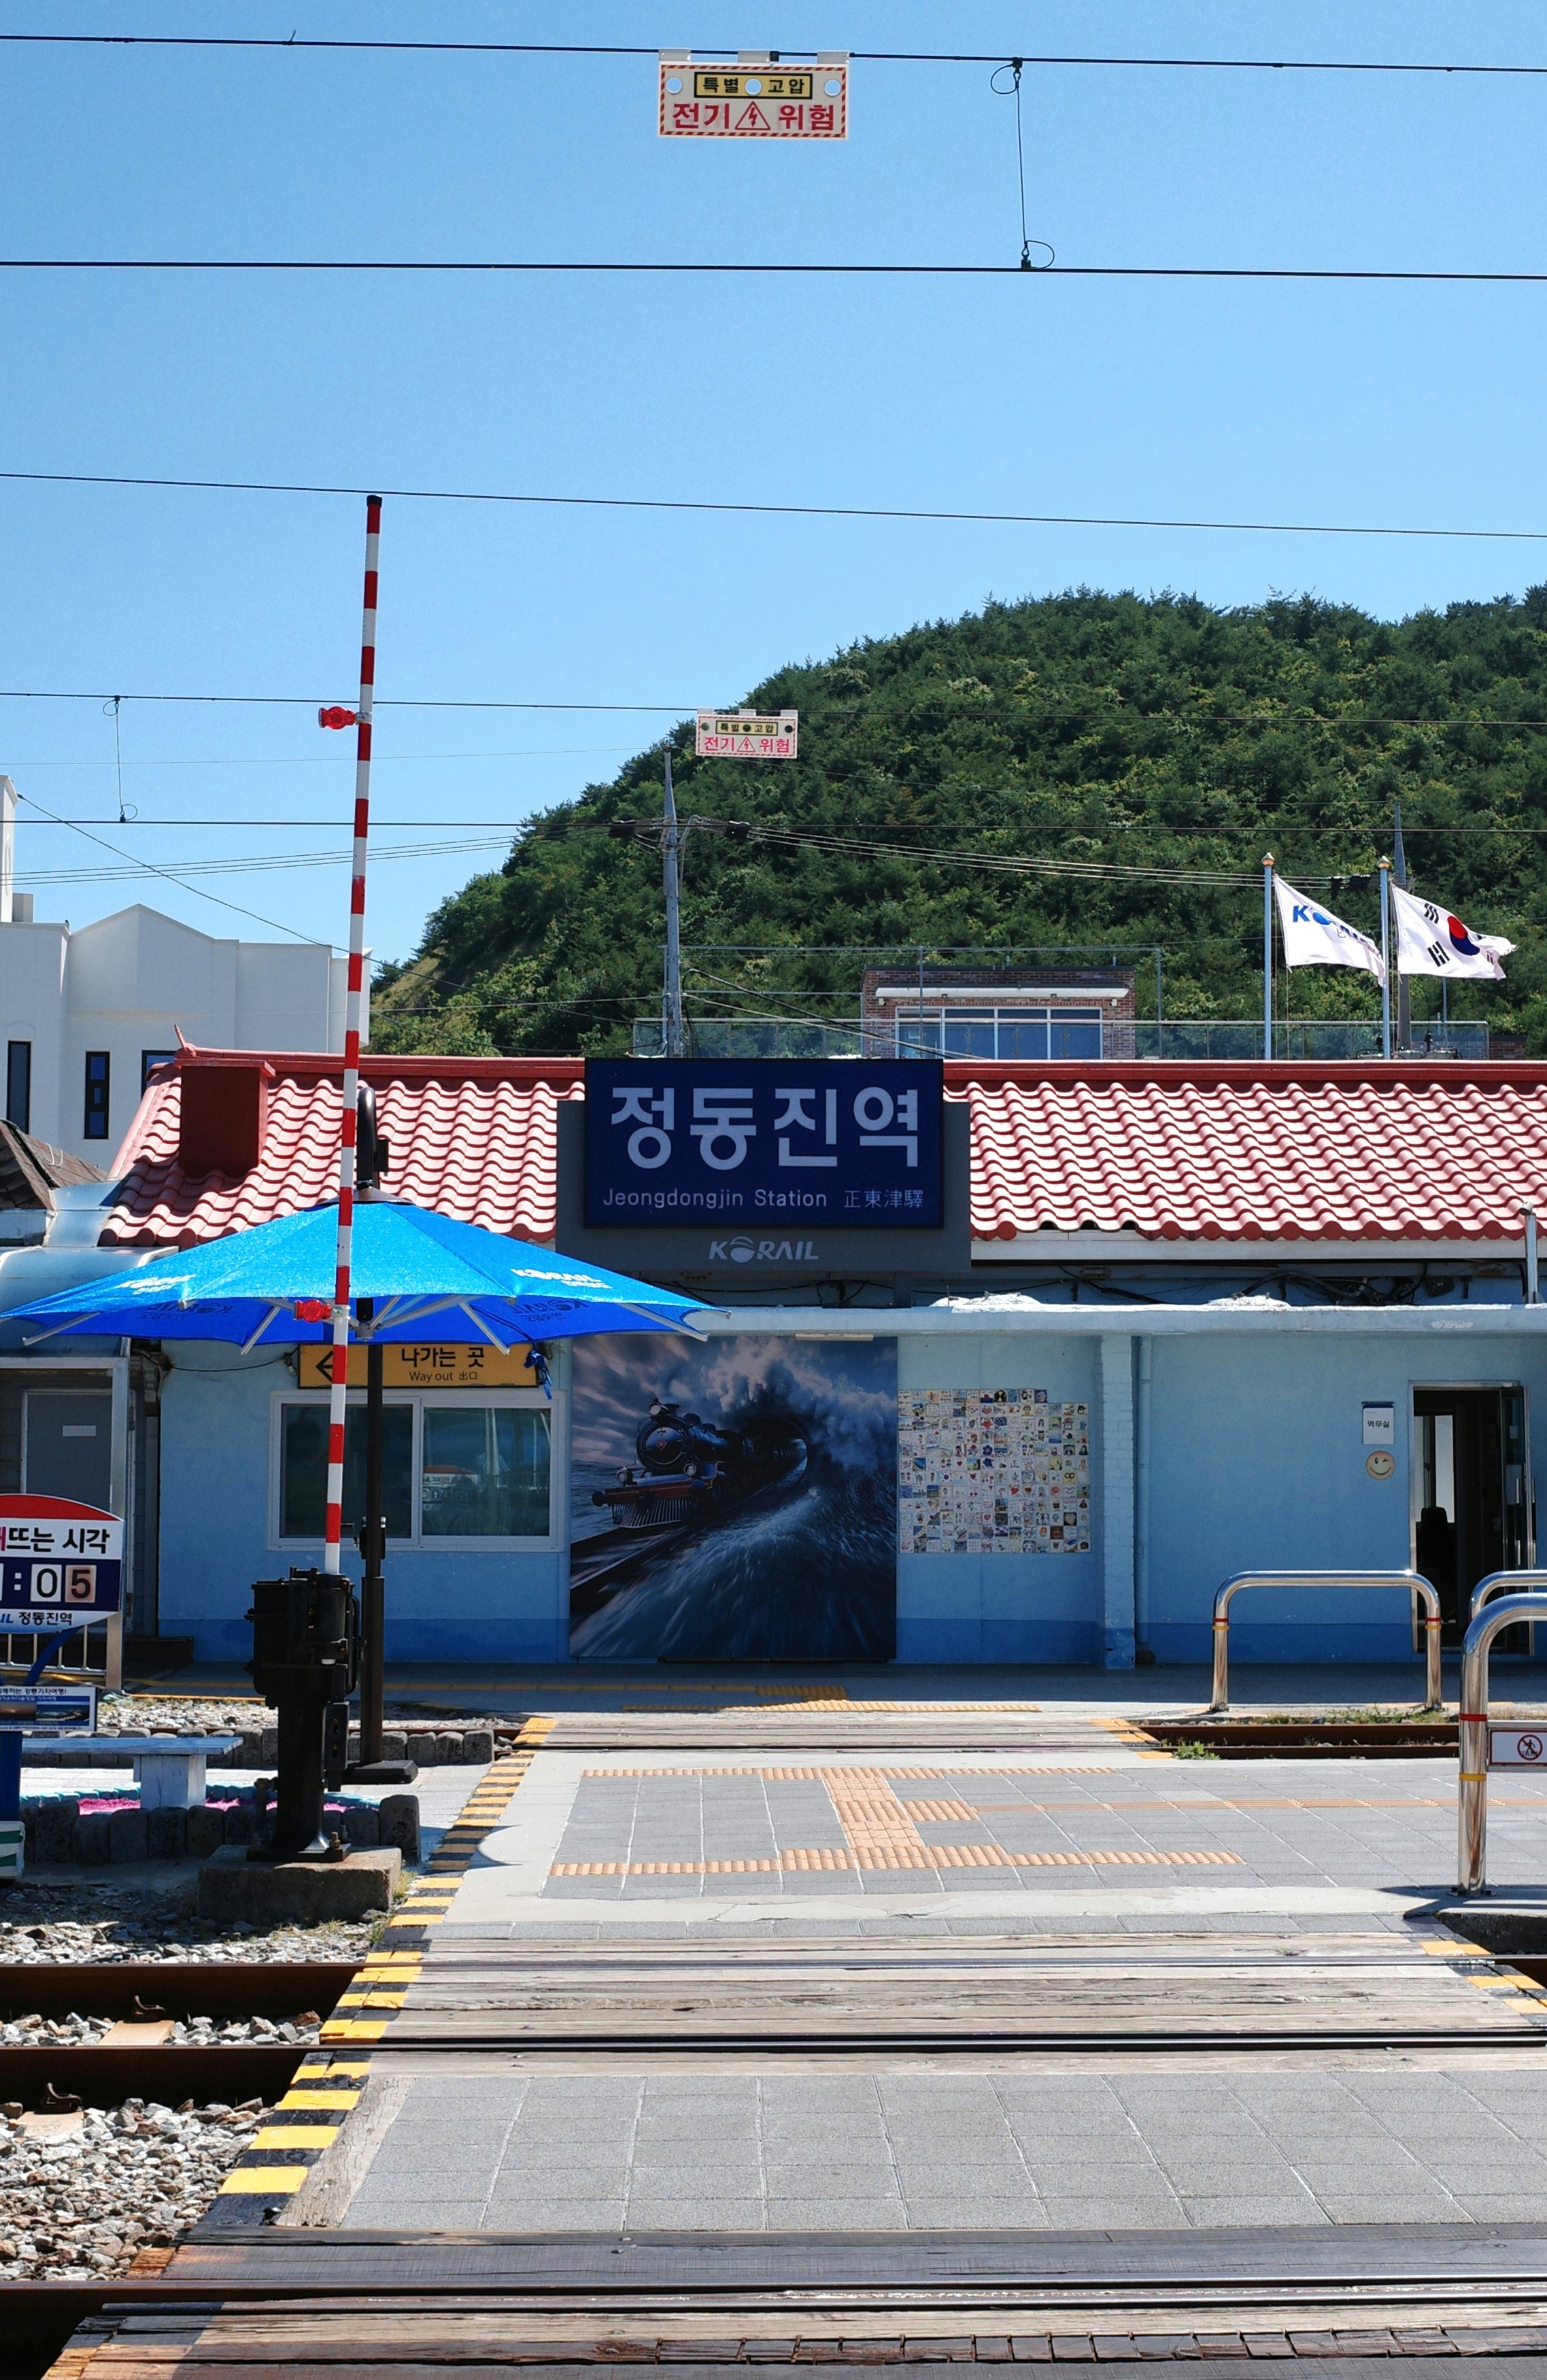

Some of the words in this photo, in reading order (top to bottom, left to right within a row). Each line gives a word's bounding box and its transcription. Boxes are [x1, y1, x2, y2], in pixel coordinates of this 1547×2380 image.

[702, 77, 738, 93] 특별
[768, 78, 804, 94] 고압
[673, 103, 730, 129] 전기
[778, 104, 834, 131] 위험
[720, 723, 739, 733] 특별
[754, 725, 774, 734] 고압
[704, 737, 734, 751] 전기
[760, 738, 789, 753] 위험
[611, 1086, 919, 1171] 정동진역
[603, 1189, 743, 1210] Jeongdongjin
[754, 1189, 828, 1208] Station
[843, 1190, 924, 1209] 正東津驛
[708, 1236, 819, 1263] KORAIL
[401, 1347, 456, 1368] 나가는
[467, 1347, 485, 1368] 곳
[409, 1371, 432, 1383] Way
[435, 1372, 454, 1381] out
[458, 1370, 478, 1381] 出口
[1367, 1420, 1390, 1428] 역무실
[0, 1526, 55, 1553] 뜨는
[62, 1528, 110, 1554] 시각
[18, 1611, 73, 1626] 정동진역
